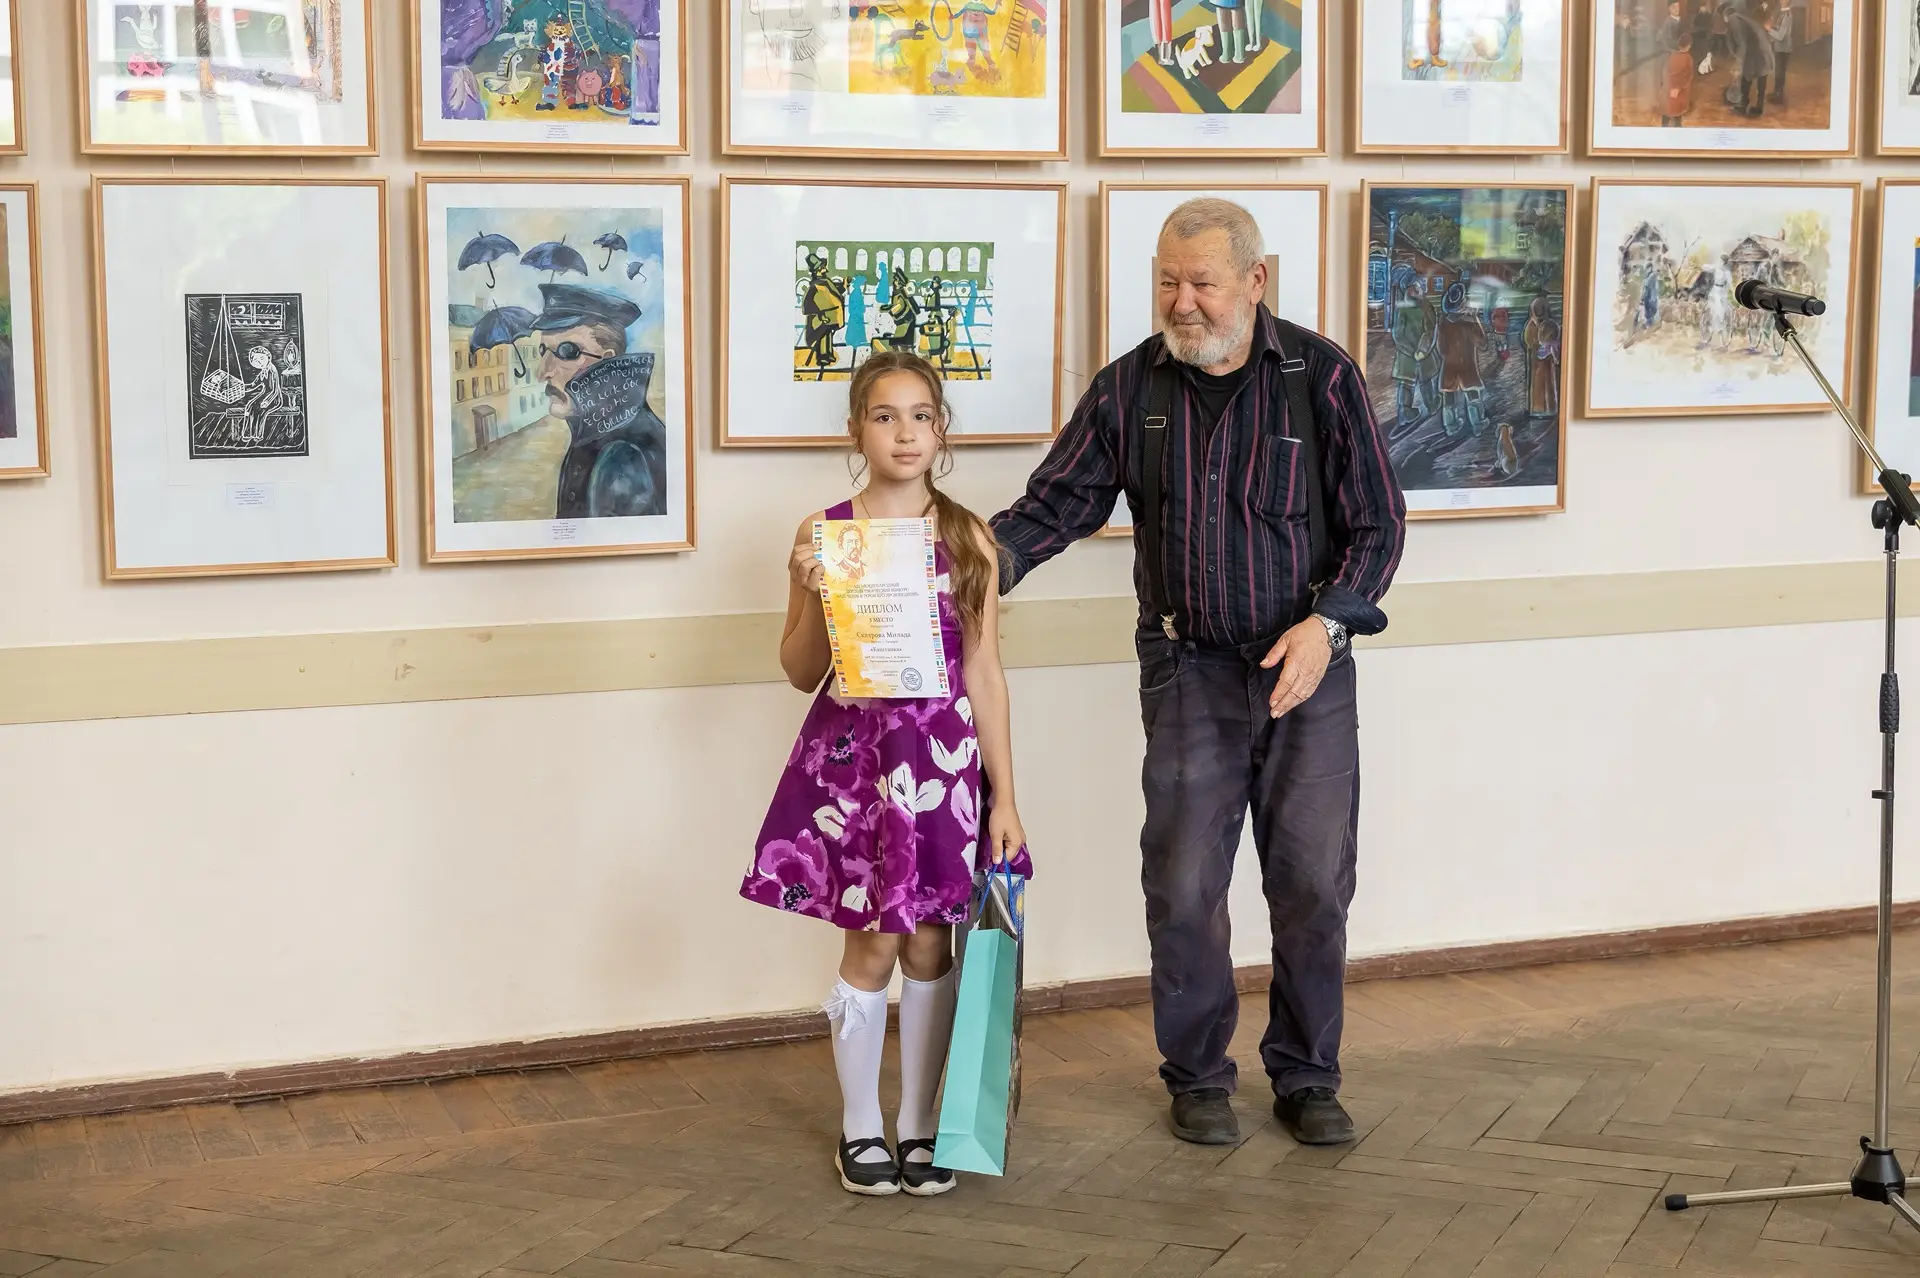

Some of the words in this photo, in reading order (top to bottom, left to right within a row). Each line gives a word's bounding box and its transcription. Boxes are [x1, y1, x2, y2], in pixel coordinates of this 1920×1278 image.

[594, 374, 610, 388] это
[623, 377, 639, 391] бы
[614, 395, 629, 407] не
[856, 603, 903, 615] ДИПЛОМ
